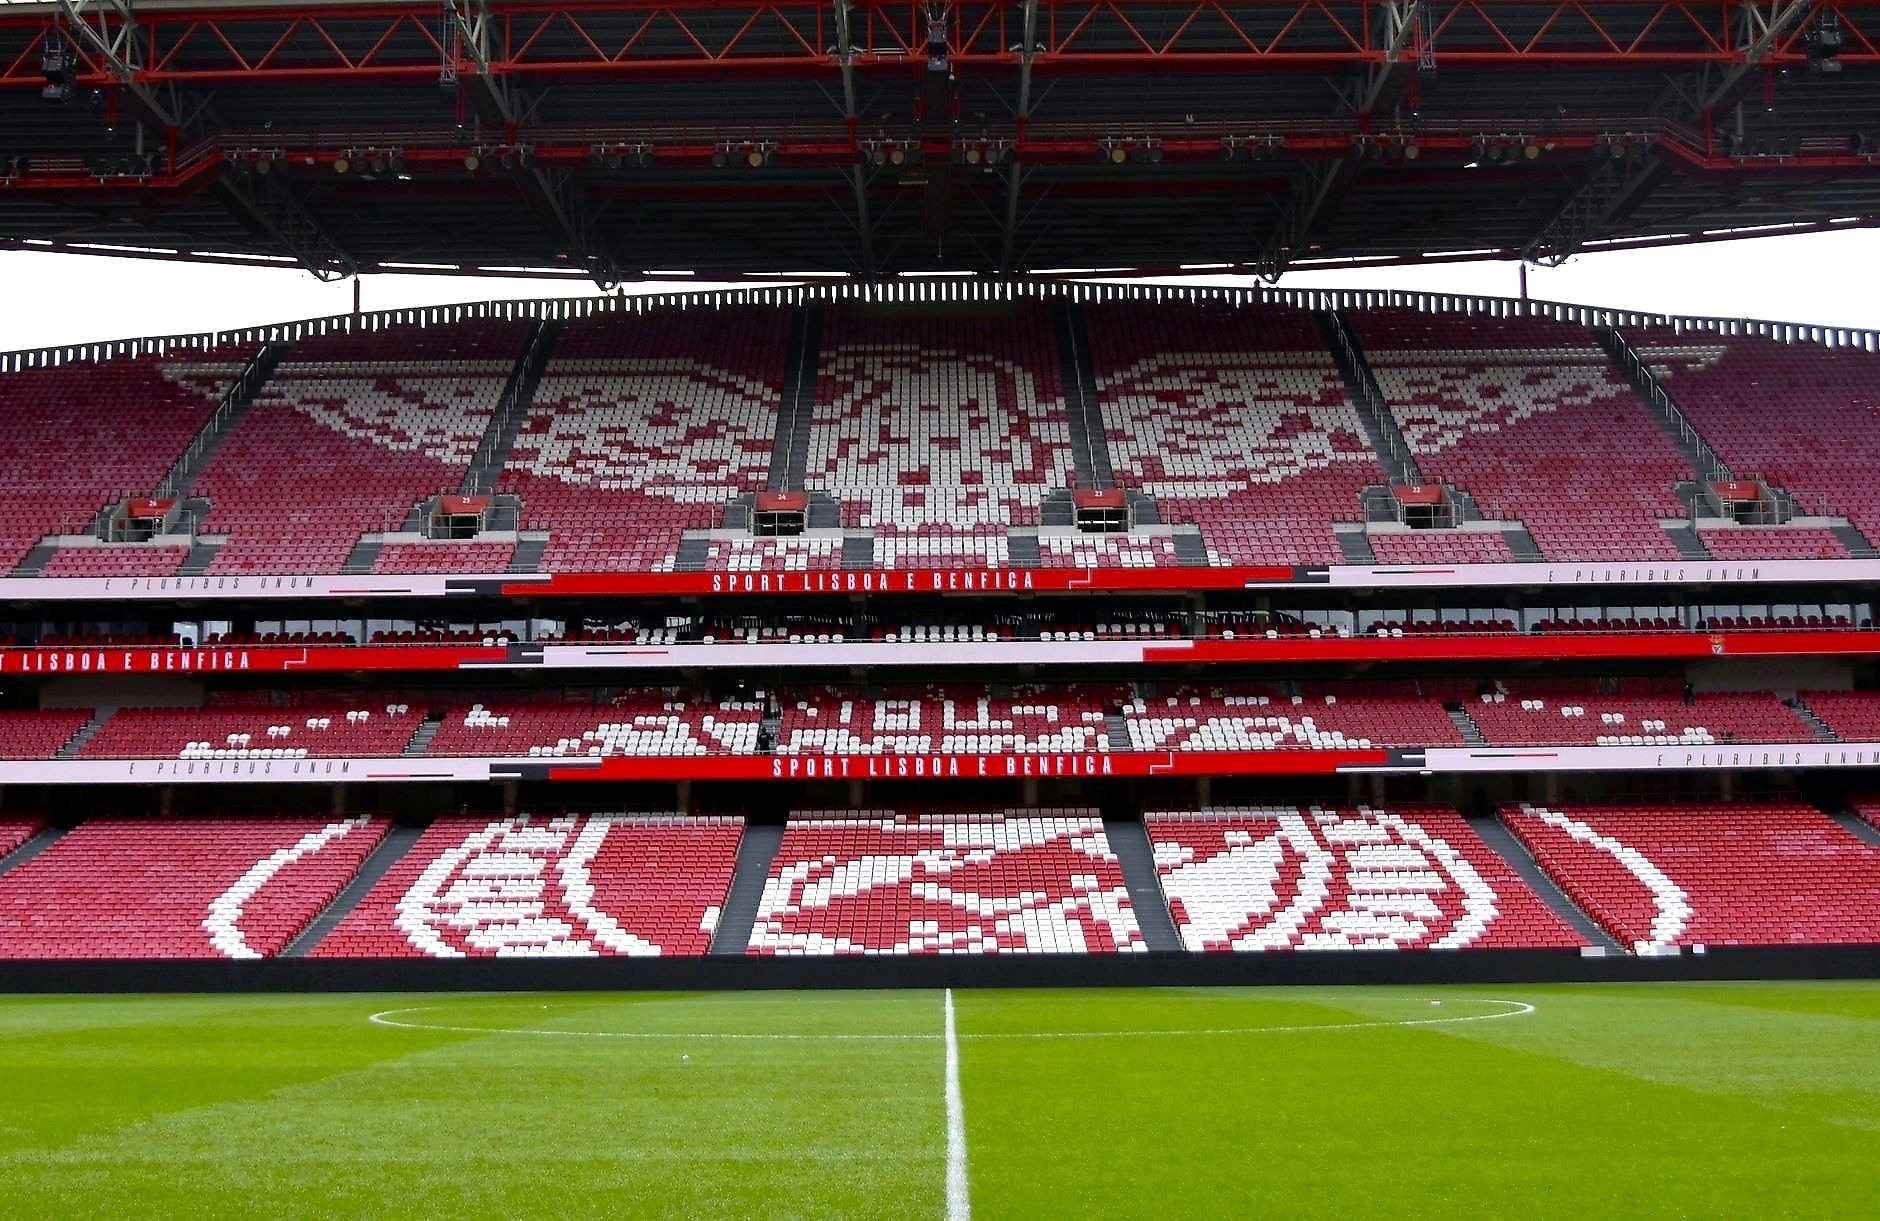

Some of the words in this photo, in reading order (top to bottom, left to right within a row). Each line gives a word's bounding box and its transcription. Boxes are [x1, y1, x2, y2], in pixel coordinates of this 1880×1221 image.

[777, 493, 786, 501] 24
[105, 577, 111, 590] E
[132, 577, 239, 590] PLURIBUS
[260, 576, 314, 589] UNUM
[713, 573, 785, 592] SPORT
[804, 572, 888, 591] LISBOA
[907, 572, 914, 590] E
[933, 571, 1033, 590] BENFICA
[1548, 570, 1554, 583] E
[1575, 568, 1685, 582] PLURIBUS
[1706, 567, 1761, 581] UNUM
[22, 652, 106, 671] LISBOA
[124, 652, 132, 670] E
[150, 651, 249, 670] BENFICA
[773, 757, 849, 777] SPORT
[869, 757, 958, 777] LISBOA
[978, 756, 986, 775] E
[1006, 755, 1112, 776] BENFICA
[1657, 754, 1663, 767] E
[1686, 752, 1802, 767] PLURIBUS
[1824, 751, 1880, 766] UNUM
[129, 761, 135, 775] E
[157, 761, 272, 775] PLURIBUS
[294, 760, 350, 774] UNUM
